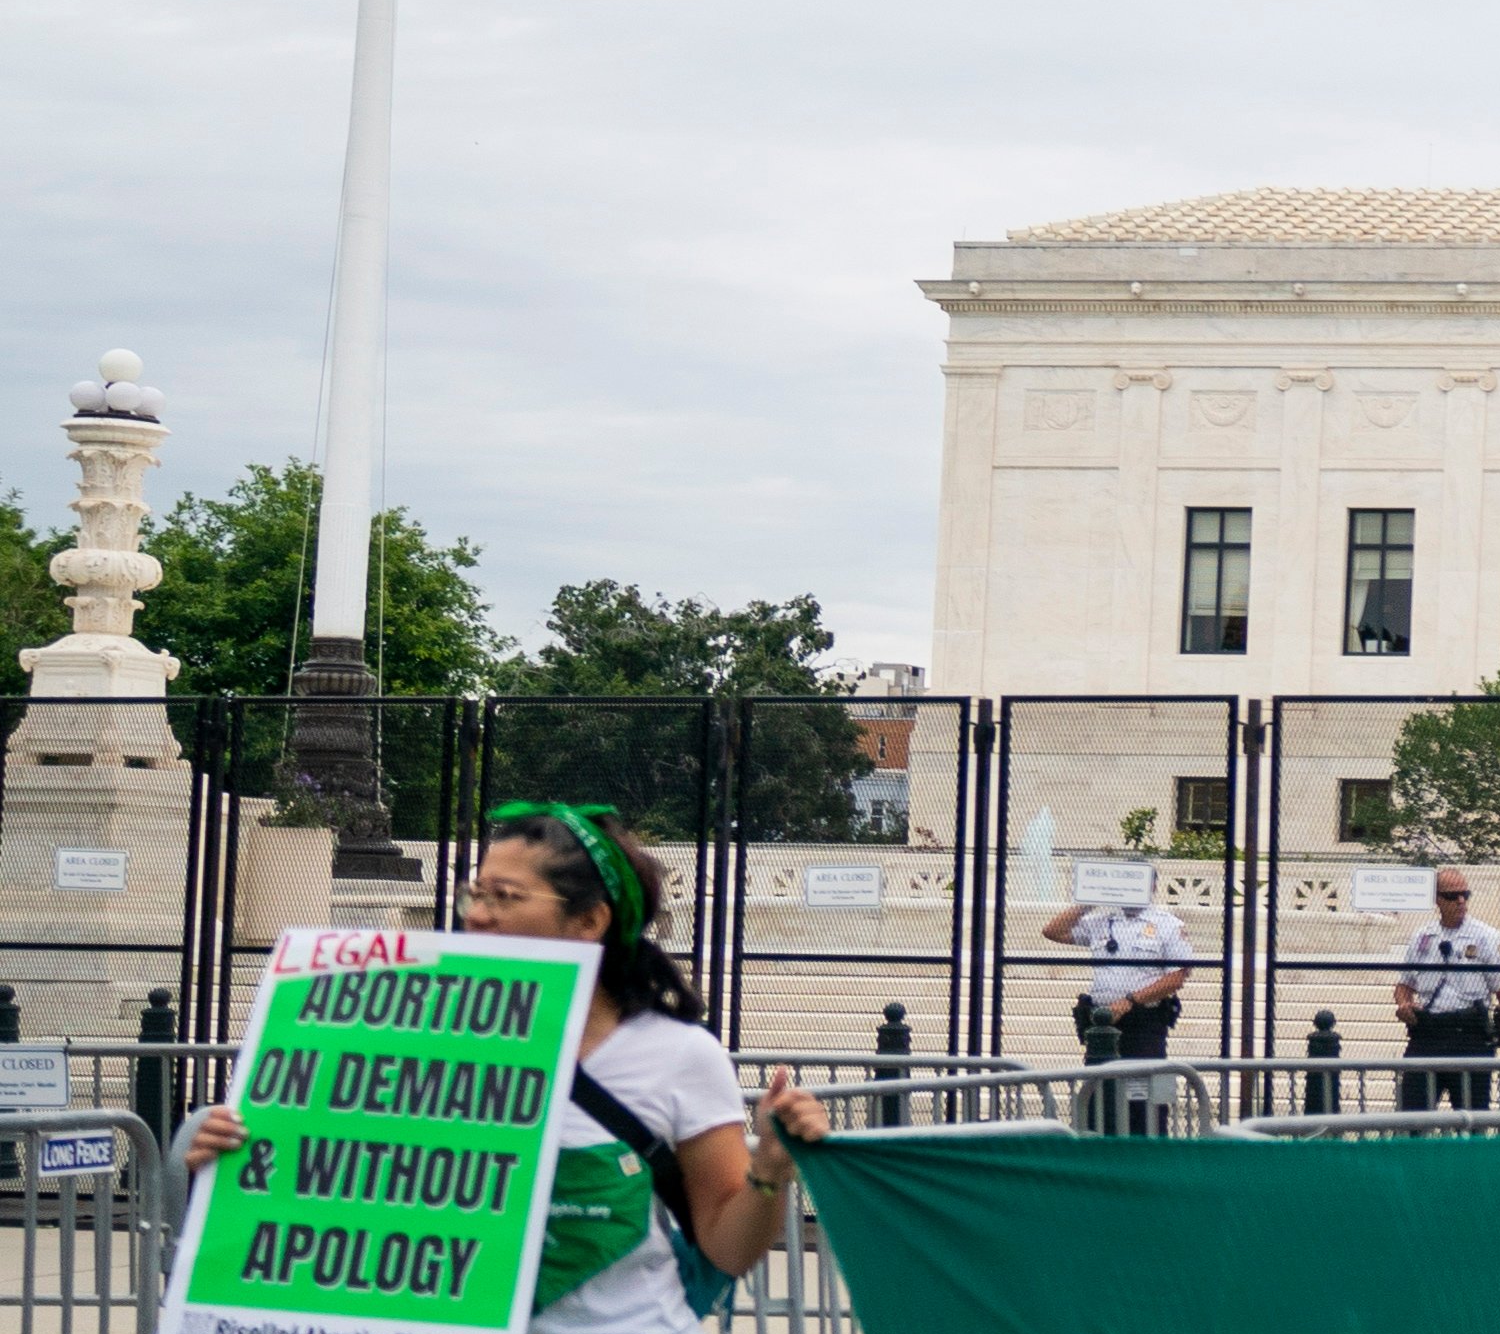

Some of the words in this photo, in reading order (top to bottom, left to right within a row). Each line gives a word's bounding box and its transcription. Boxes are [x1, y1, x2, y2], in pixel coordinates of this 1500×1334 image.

[273, 931, 419, 976] LEGAL
[298, 970, 540, 1041] ABORTION
[2, 1058, 55, 1071] CLOSED
[249, 1047, 319, 1108] ON
[329, 1052, 548, 1127] DEMAND
[44, 1142, 75, 1168] LONG
[76, 1140, 111, 1166] FENCE
[238, 1137, 277, 1195] &
[296, 1134, 520, 1214] WITHOUT
[241, 1221, 481, 1300] APOLOGY
